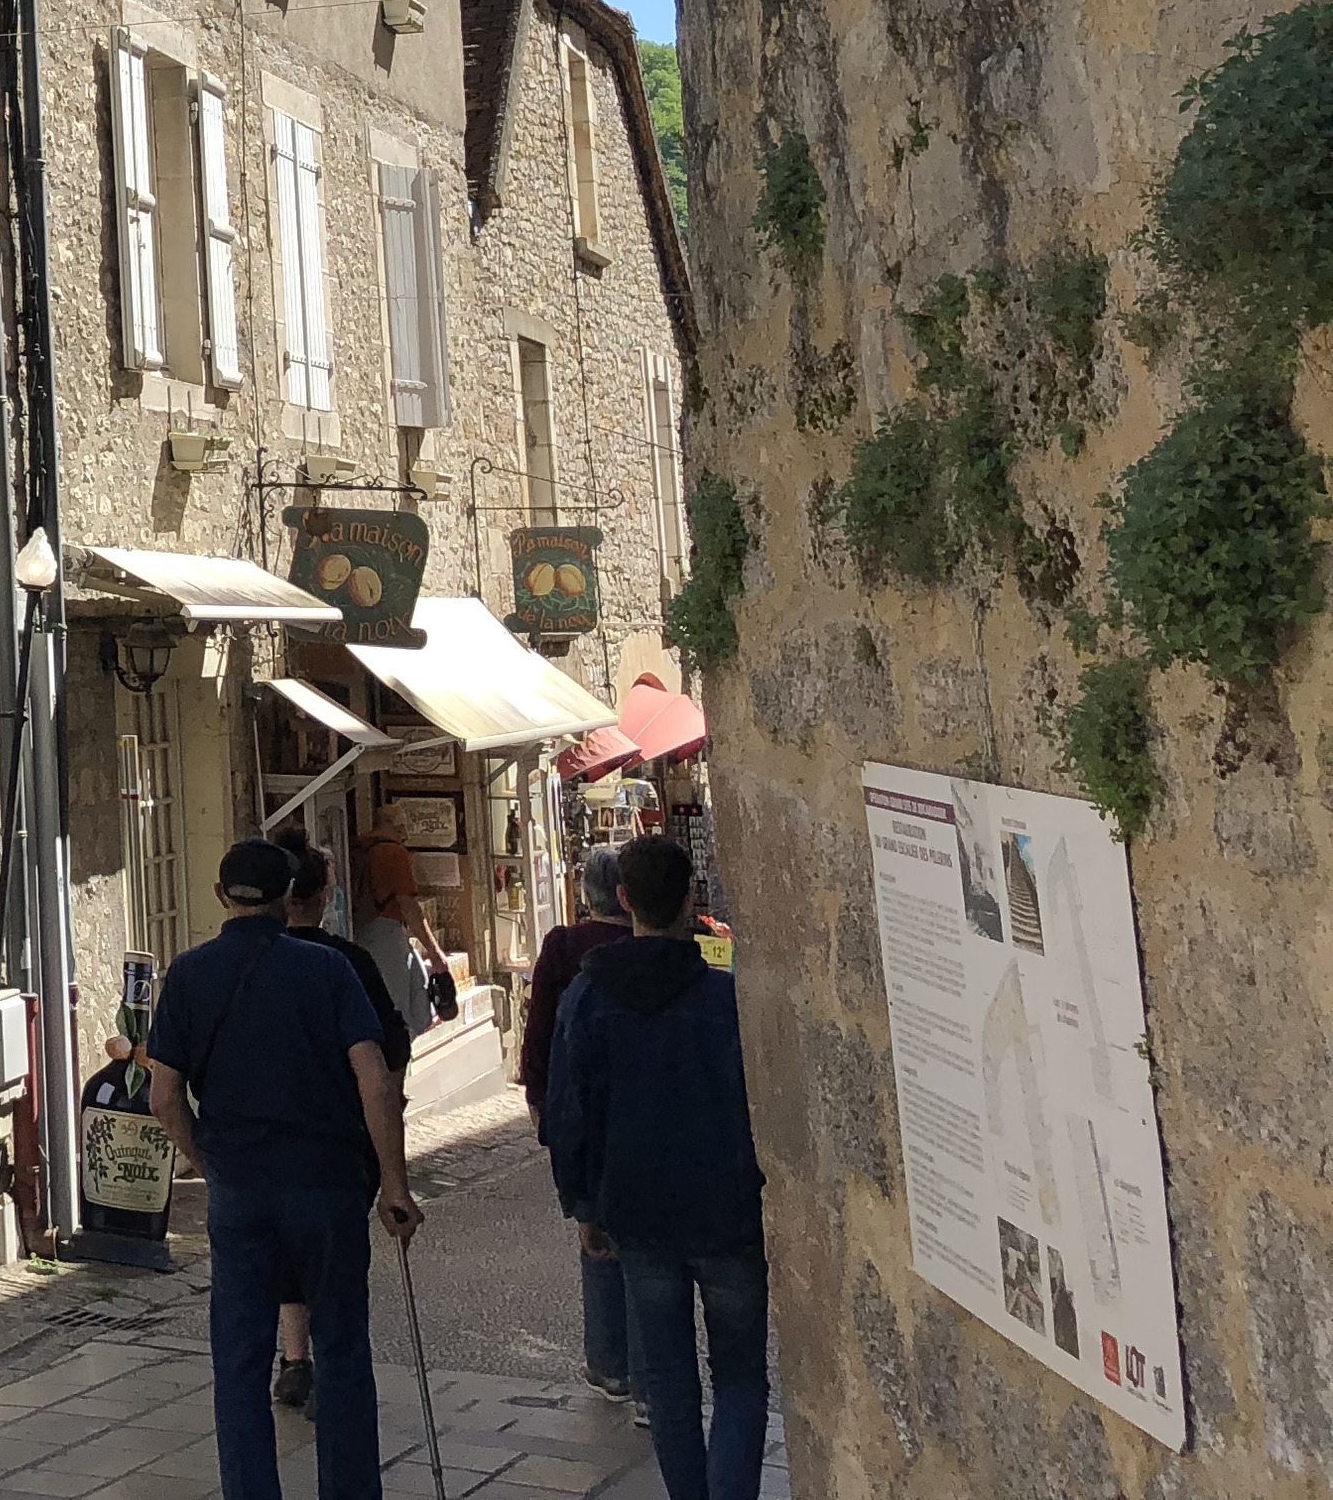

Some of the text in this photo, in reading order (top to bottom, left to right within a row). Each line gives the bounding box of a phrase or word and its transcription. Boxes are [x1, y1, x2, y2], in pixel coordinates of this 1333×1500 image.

[350, 522, 425, 567] maison
[358, 612, 417, 641] noix
[539, 608, 553, 629] la
